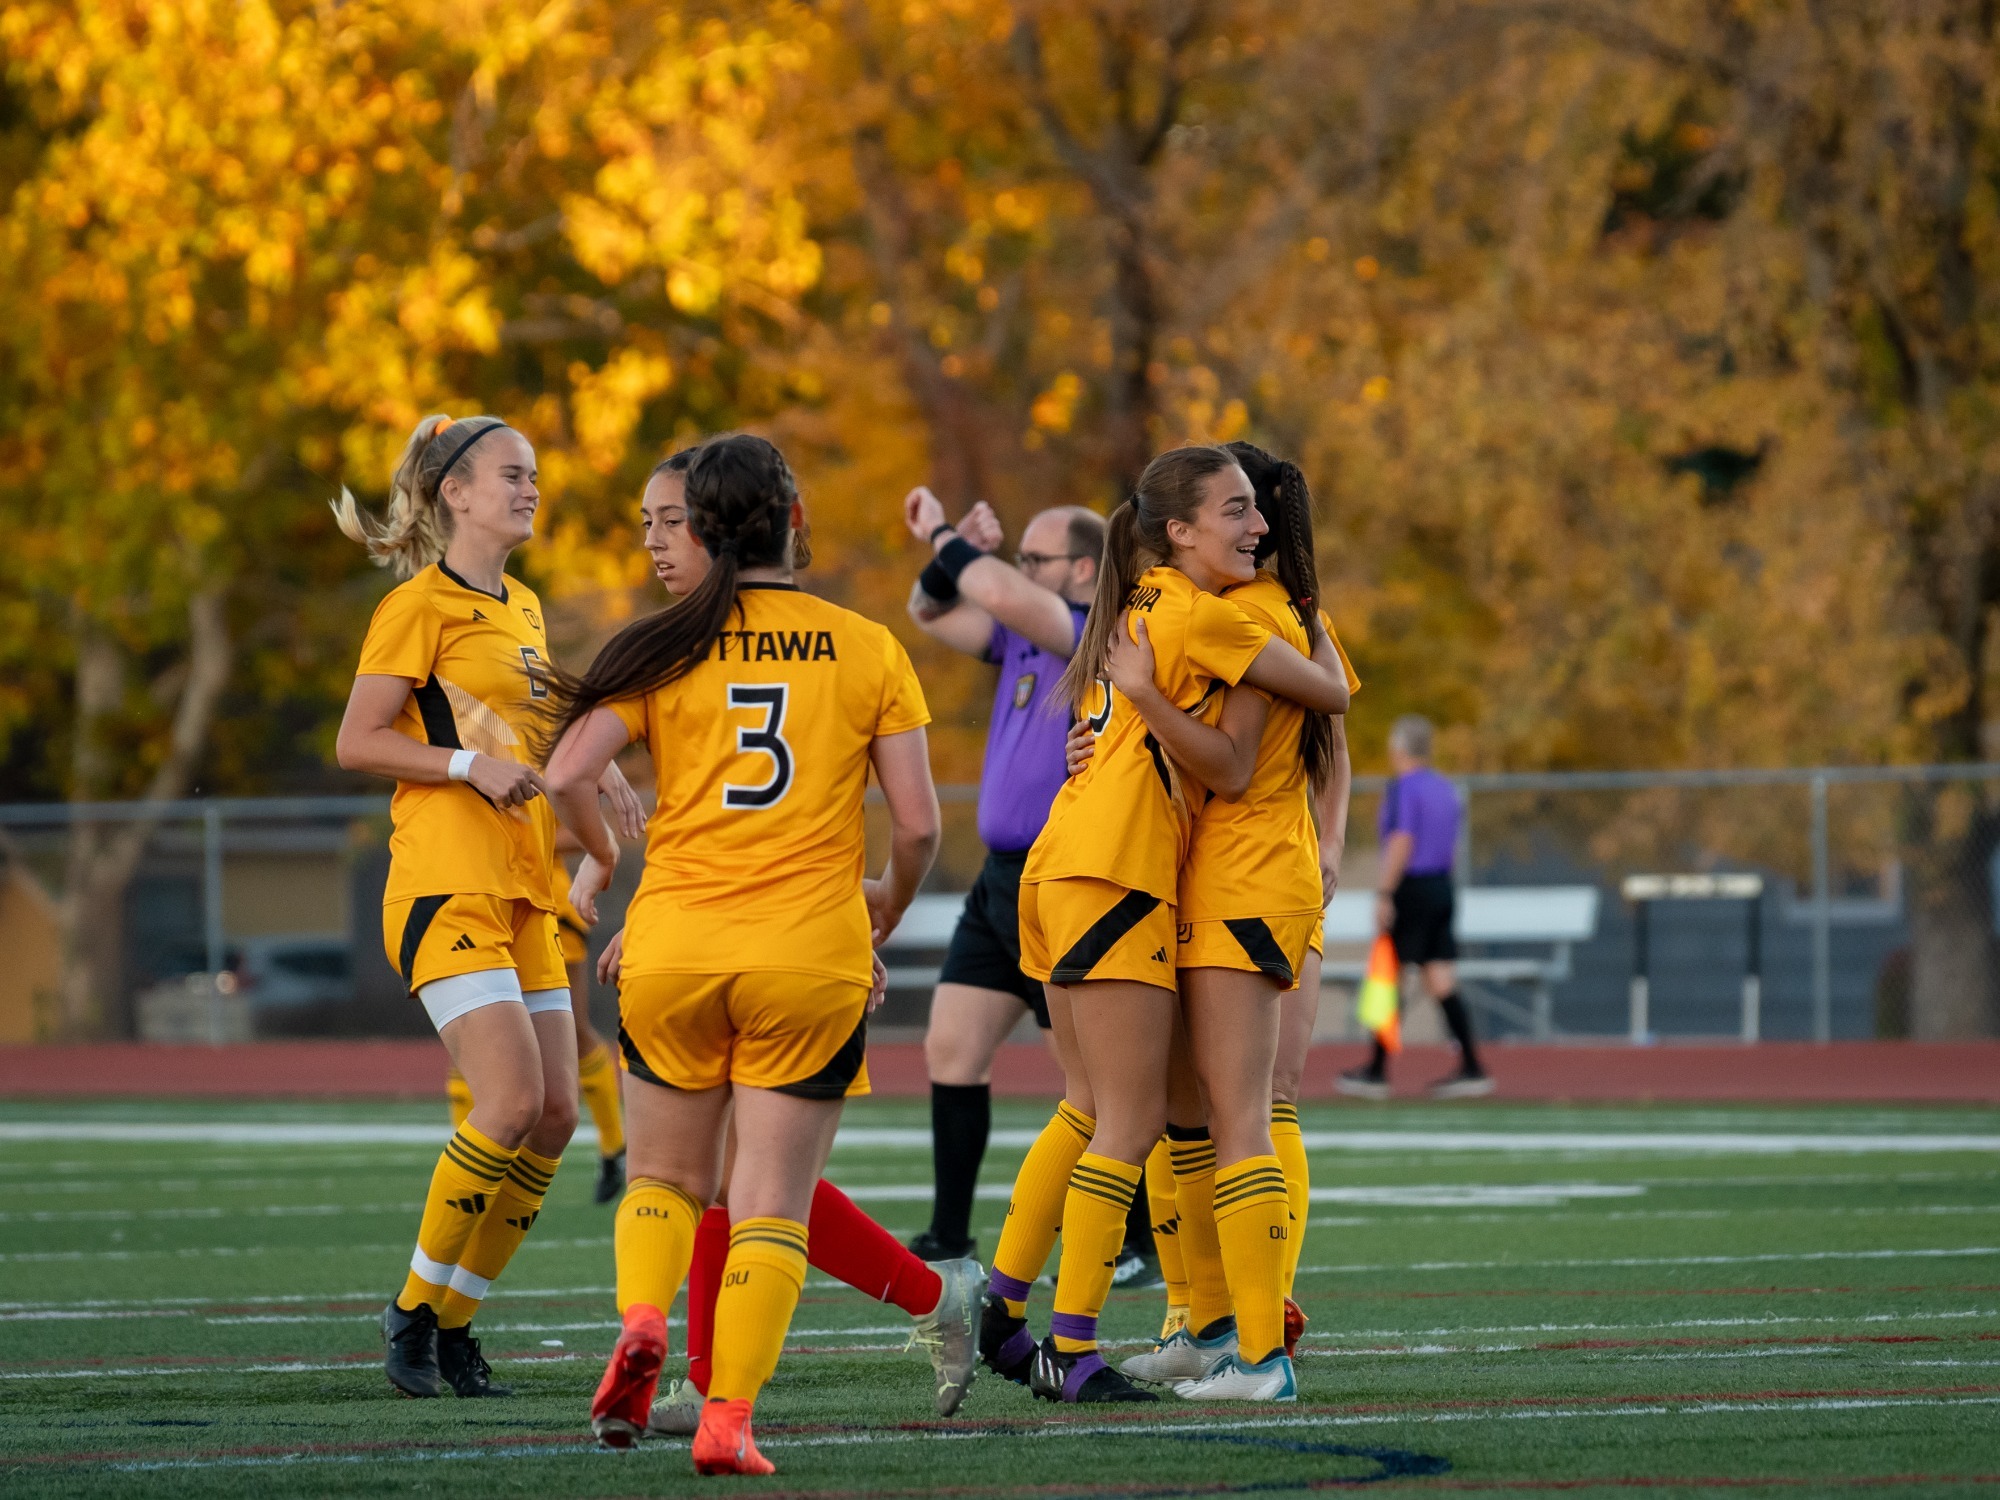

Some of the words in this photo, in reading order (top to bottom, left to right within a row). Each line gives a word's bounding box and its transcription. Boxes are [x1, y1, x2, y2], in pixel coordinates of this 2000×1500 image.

[701, 630, 837, 662] TTAWA
[721, 683, 795, 810] 3
[635, 1206, 668, 1219] OU
[1269, 1225, 1288, 1240] OU
[725, 1270, 750, 1288] OU
